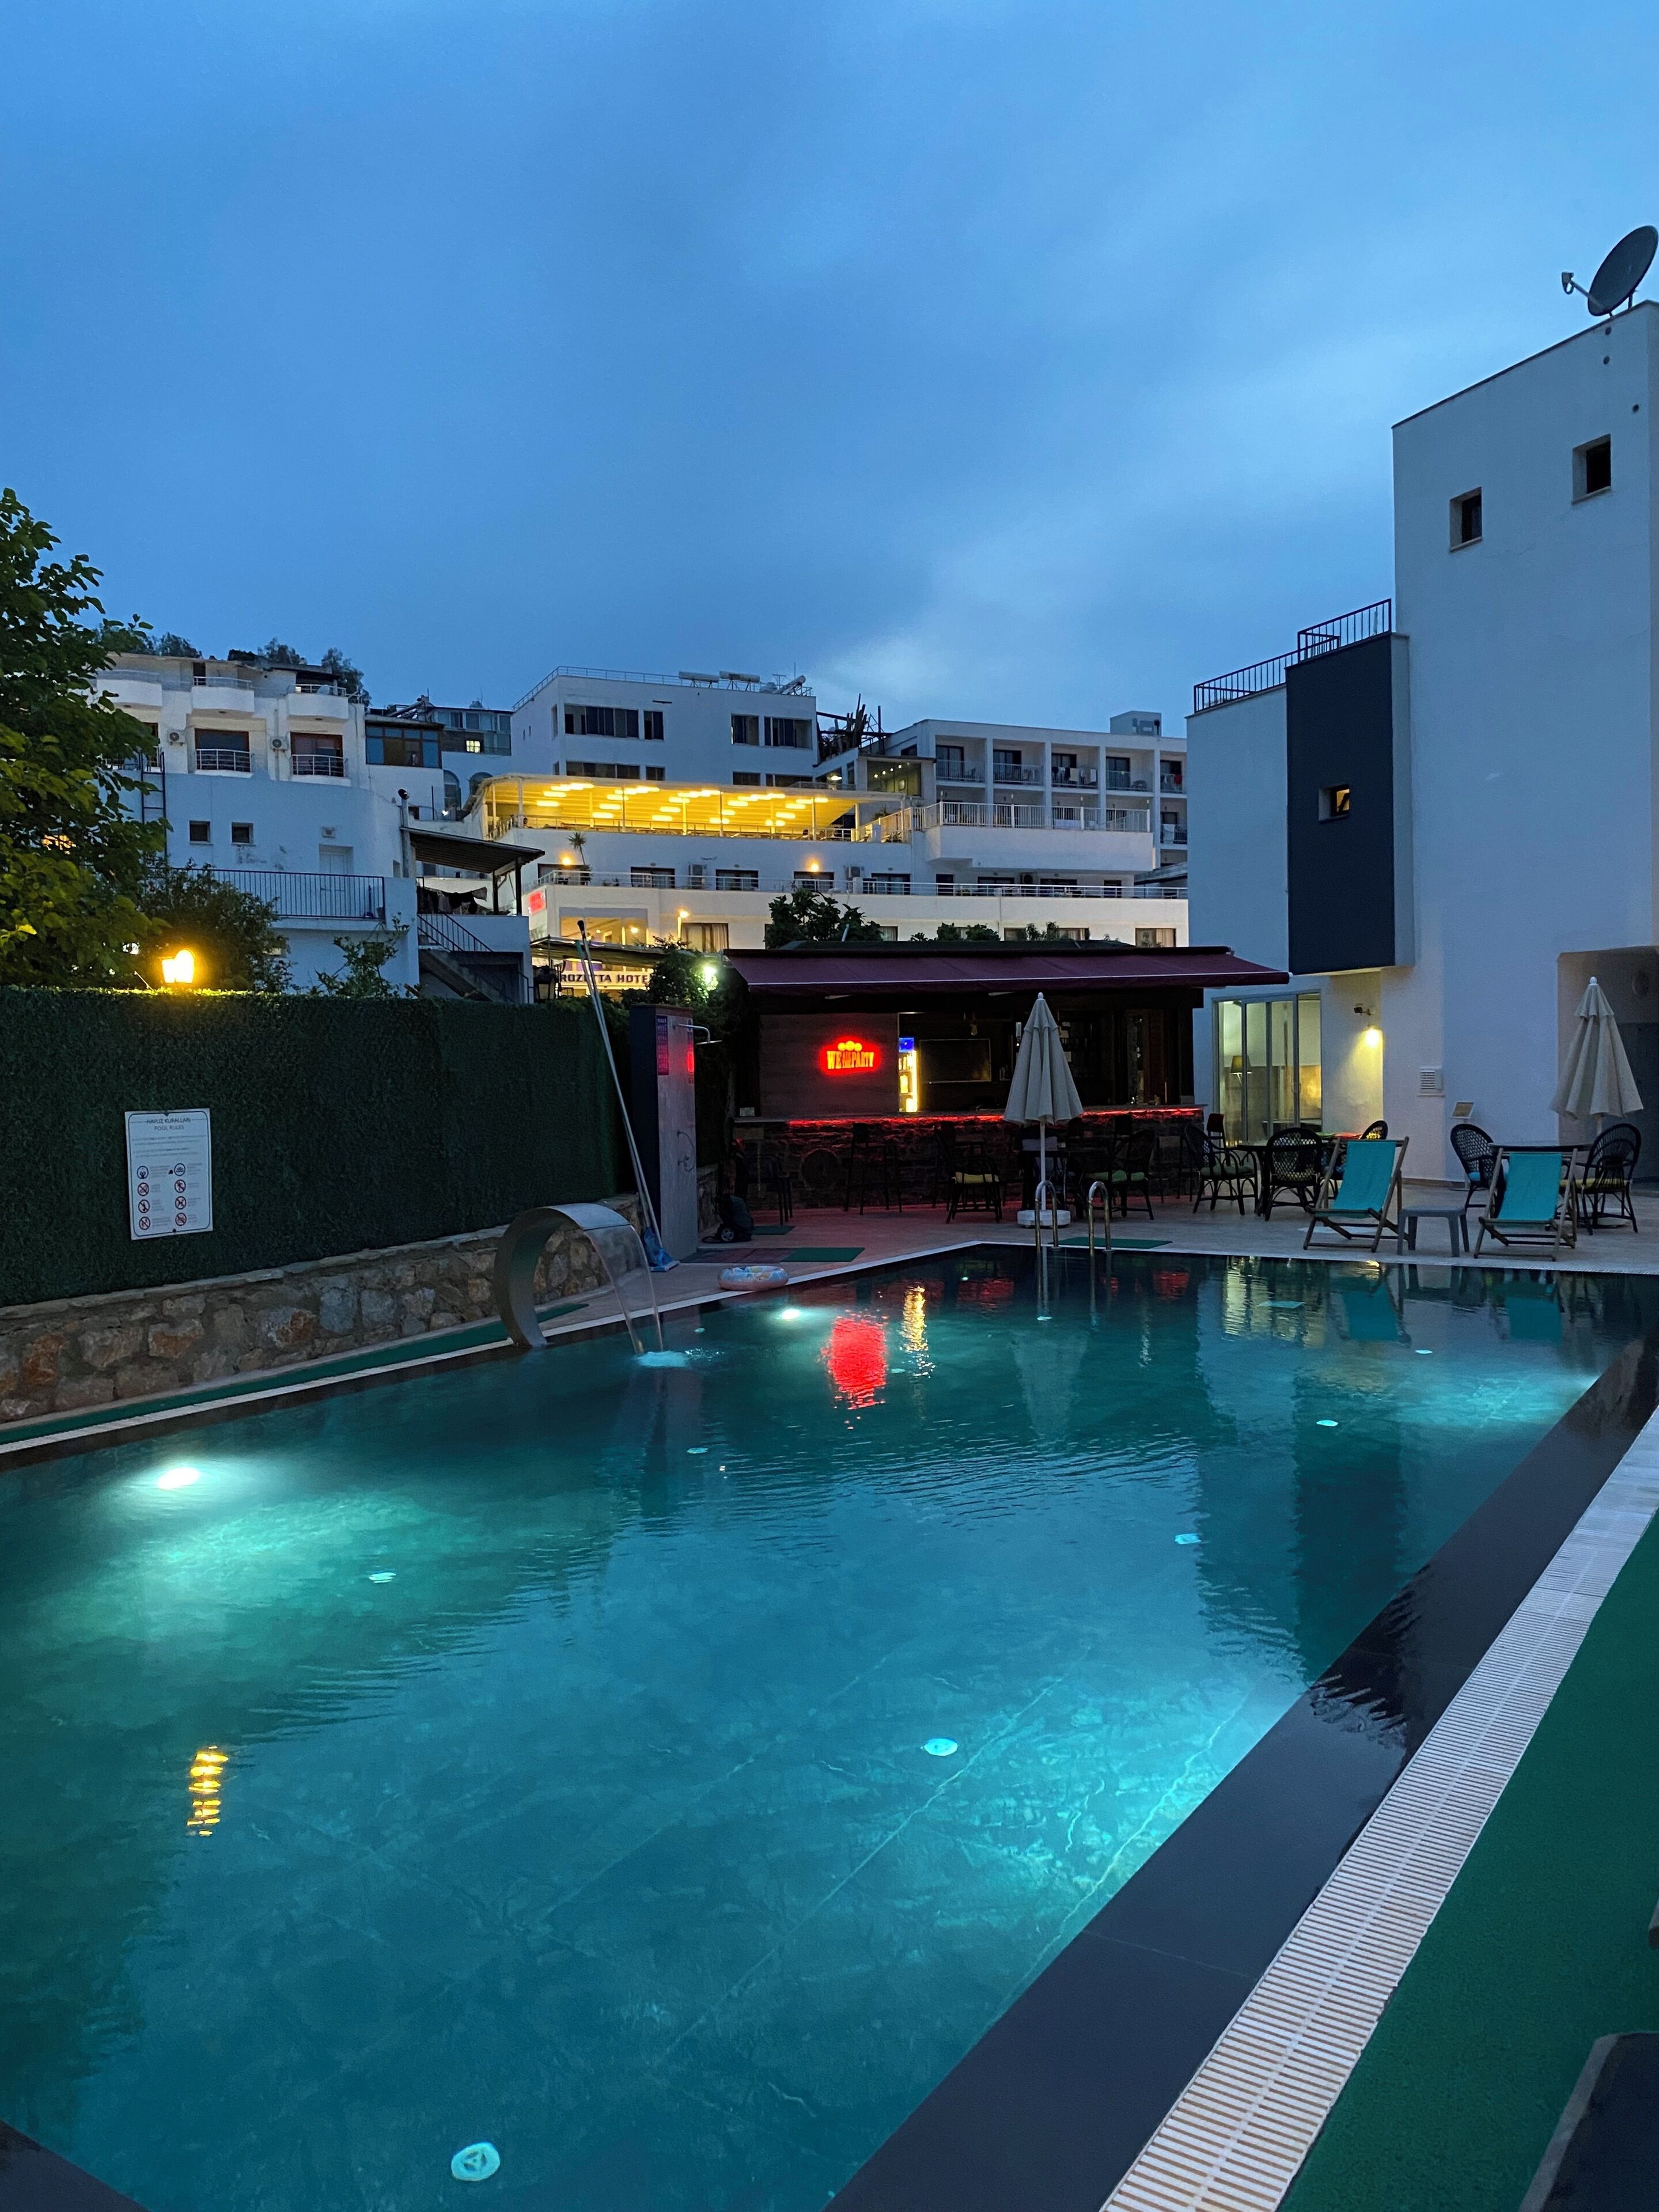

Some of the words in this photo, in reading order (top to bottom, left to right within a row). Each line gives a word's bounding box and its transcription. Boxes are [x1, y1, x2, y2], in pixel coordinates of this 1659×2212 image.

[561, 974, 612, 983] ROZTA
[618, 974, 652, 984] HOTE
[827, 1051, 842, 1070] WE
